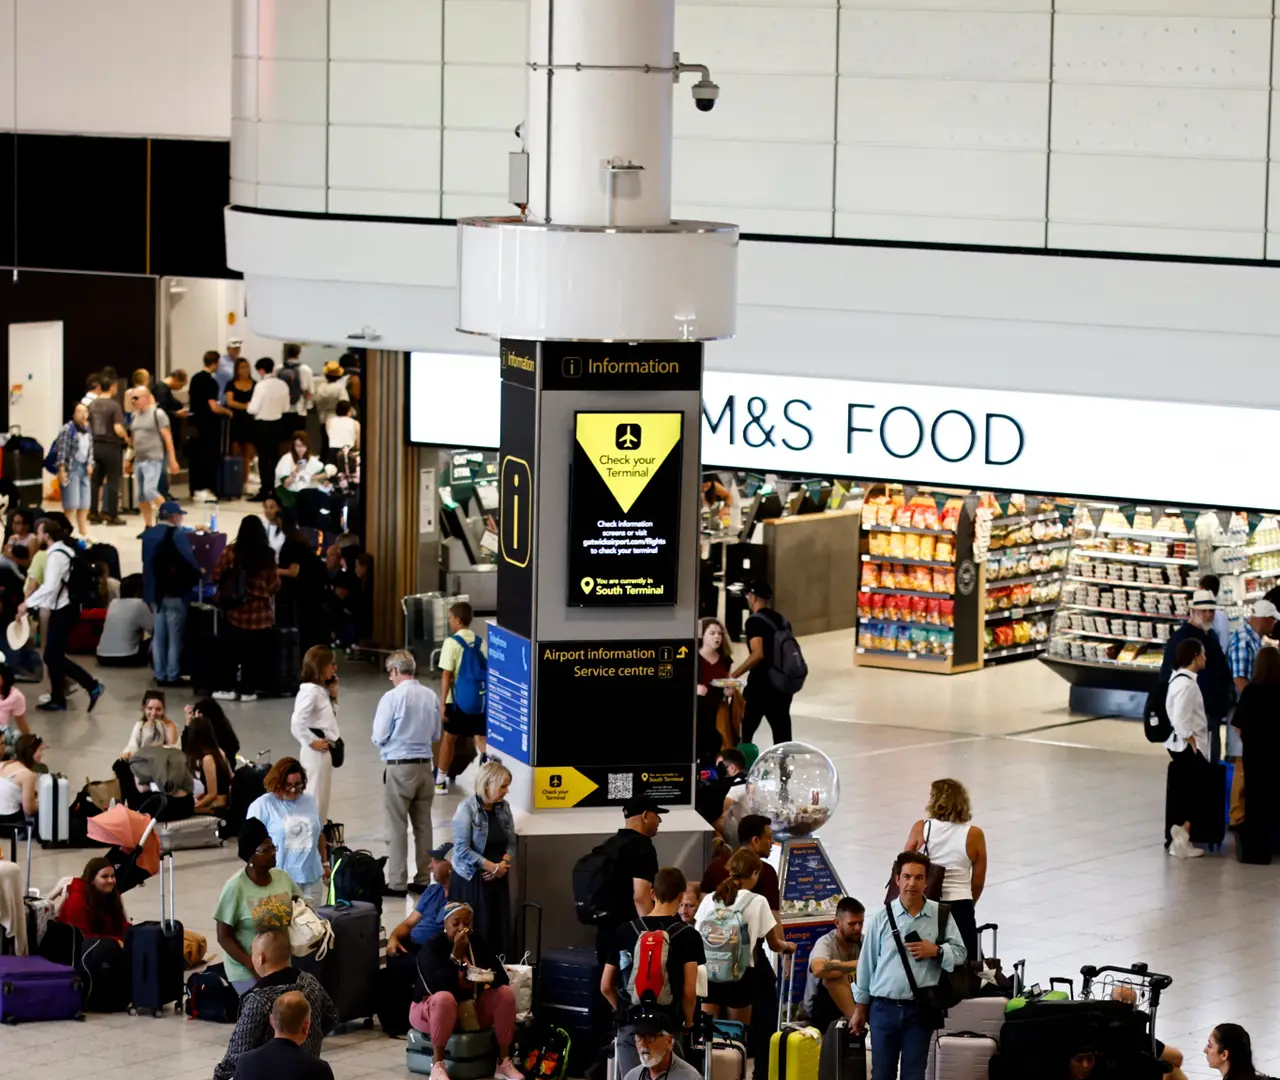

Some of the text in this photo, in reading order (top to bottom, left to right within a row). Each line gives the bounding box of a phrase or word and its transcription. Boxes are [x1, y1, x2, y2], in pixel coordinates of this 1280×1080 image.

[588, 357, 679, 374] Information
[701, 395, 1025, 466] M&S FOOD
[599, 454, 656, 468] Check your
[606, 467, 649, 478] Terminal
[597, 520, 653, 528] Check information
[620, 577, 646, 586] currently
[596, 584, 664, 595] South Terminal
[543, 648, 585, 663] Airport
[587, 648, 656, 660] information
[574, 665, 655, 677] Service centre
